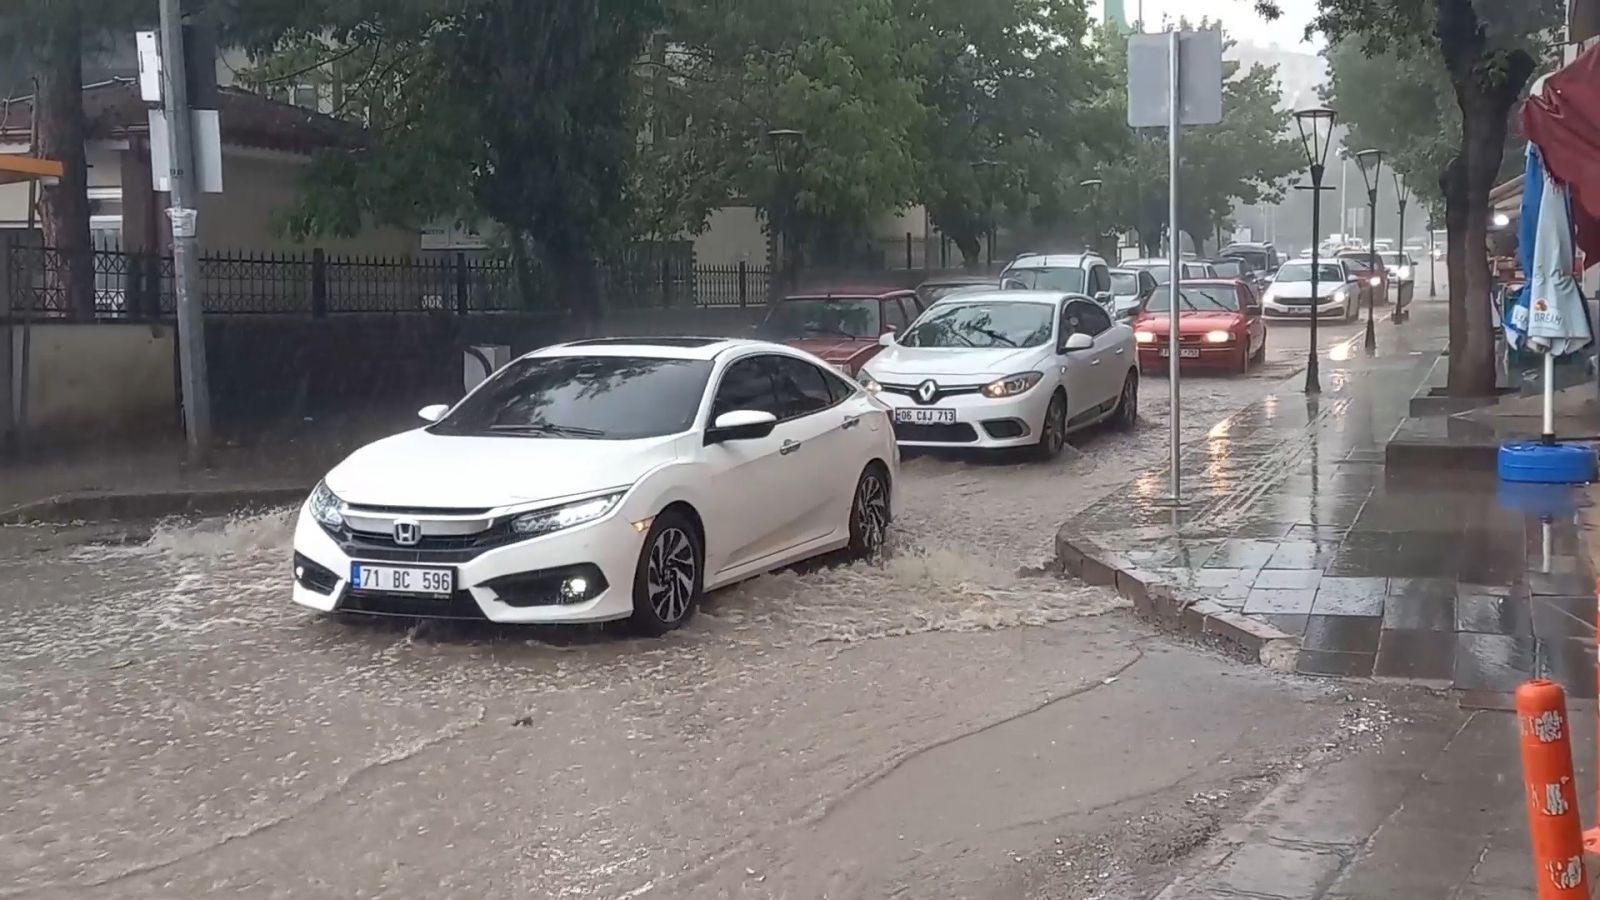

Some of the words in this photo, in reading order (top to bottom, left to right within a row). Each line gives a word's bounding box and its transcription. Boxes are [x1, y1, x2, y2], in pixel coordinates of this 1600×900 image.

[901, 410, 912, 420] 06
[937, 411, 954, 421] 713
[363, 568, 380, 587] 71
[393, 570, 411, 589] BC
[422, 571, 451, 591] 596
